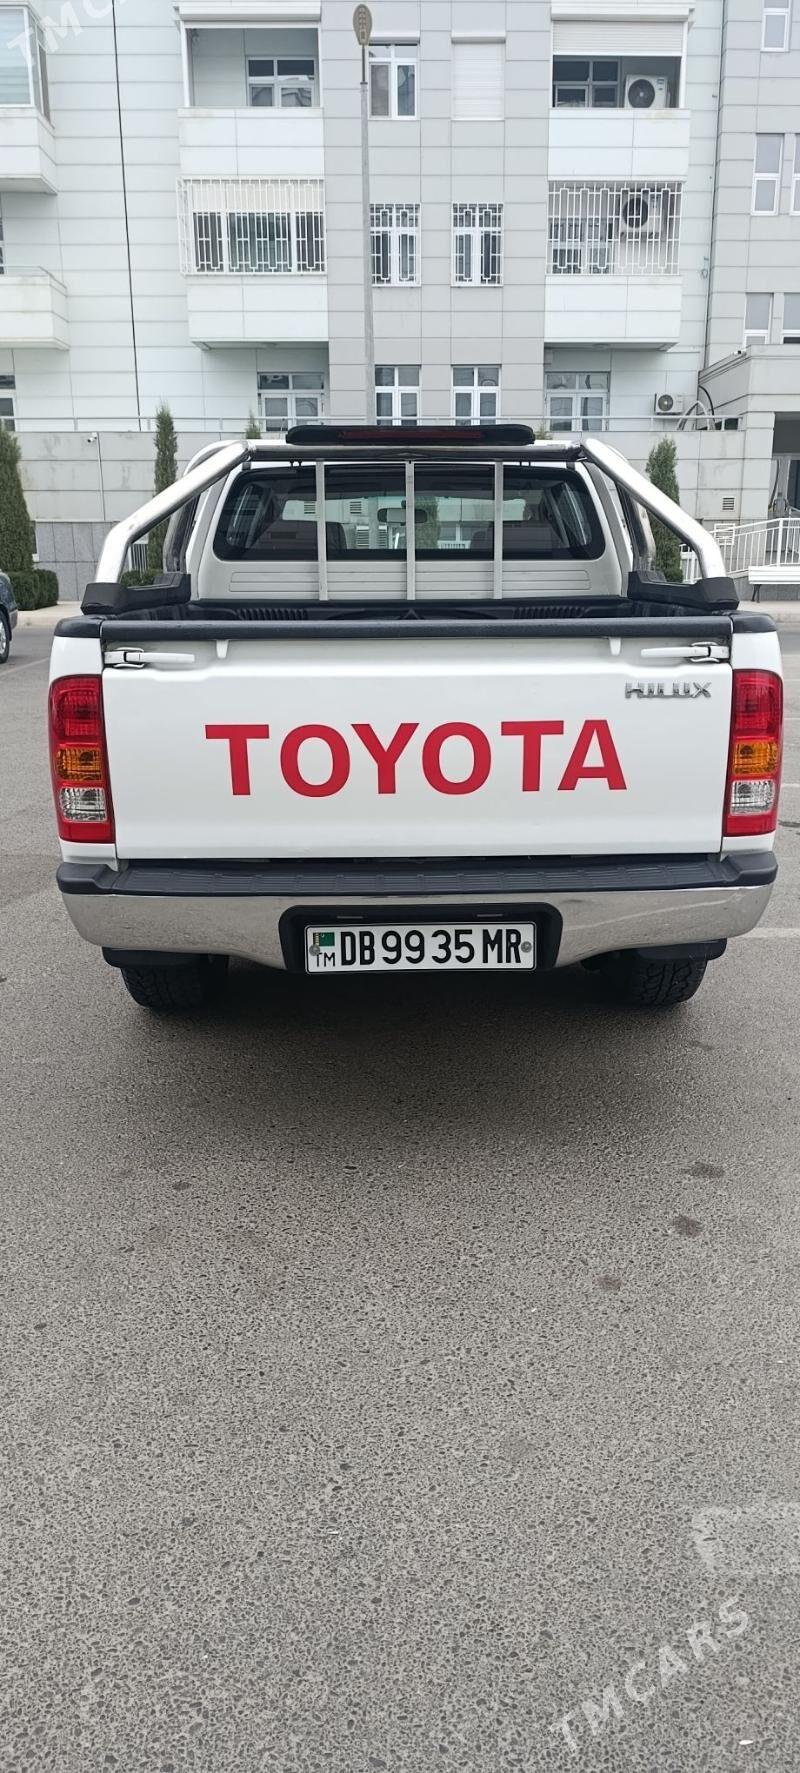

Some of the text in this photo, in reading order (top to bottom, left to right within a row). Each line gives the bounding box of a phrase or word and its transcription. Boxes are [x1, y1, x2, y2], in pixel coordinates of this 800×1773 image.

[625, 681, 712, 699] HILUX
[205, 719, 627, 797] TOYOTA
[314, 952, 335, 967] TM
